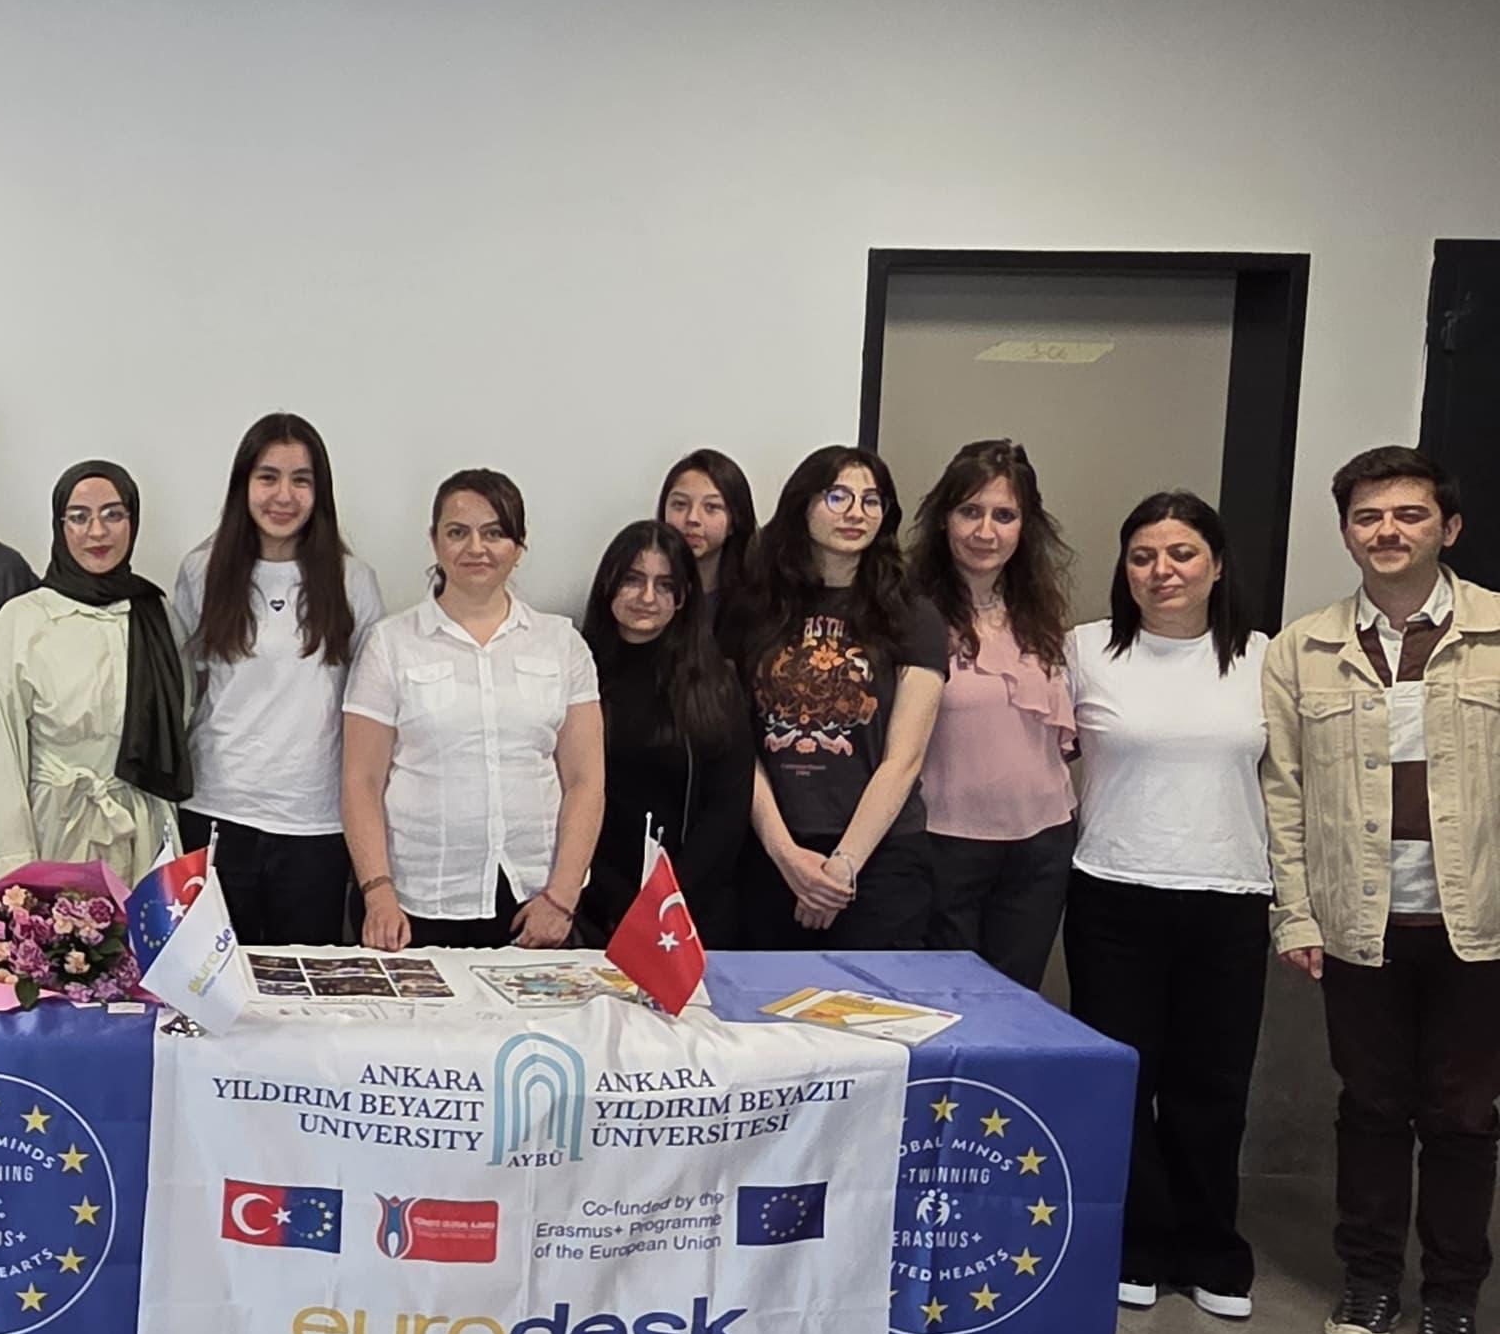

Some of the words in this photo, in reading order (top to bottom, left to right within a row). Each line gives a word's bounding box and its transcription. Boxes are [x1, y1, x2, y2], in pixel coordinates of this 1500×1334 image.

[187, 927, 233, 994] eurode
[359, 1064, 485, 1092] ANKARA
[595, 1068, 717, 1093] ANKARA
[212, 1077, 351, 1112] YILDIRIM
[359, 1092, 484, 1122] BEYAZIT
[594, 1093, 732, 1120] YILDIRIM
[739, 1079, 856, 1113] BEYAZIT
[298, 1113, 484, 1151] UNIVERSITY
[591, 1108, 791, 1148] ÜNİVERSİTESİ
[507, 1149, 564, 1167] AYBÜ
[951, 1138, 1013, 1171] MINDS
[582, 1197, 671, 1216] Co-funded
[674, 1194, 694, 1211] by
[700, 1192, 724, 1206] the
[536, 1222, 623, 1238] Erasmus+
[629, 1214, 722, 1235] Programme
[534, 1244, 552, 1259] of
[556, 1244, 584, 1260] the
[589, 1238, 667, 1260] European
[673, 1235, 721, 1250] Union
[939, 1248, 1009, 1281] HEARTS
